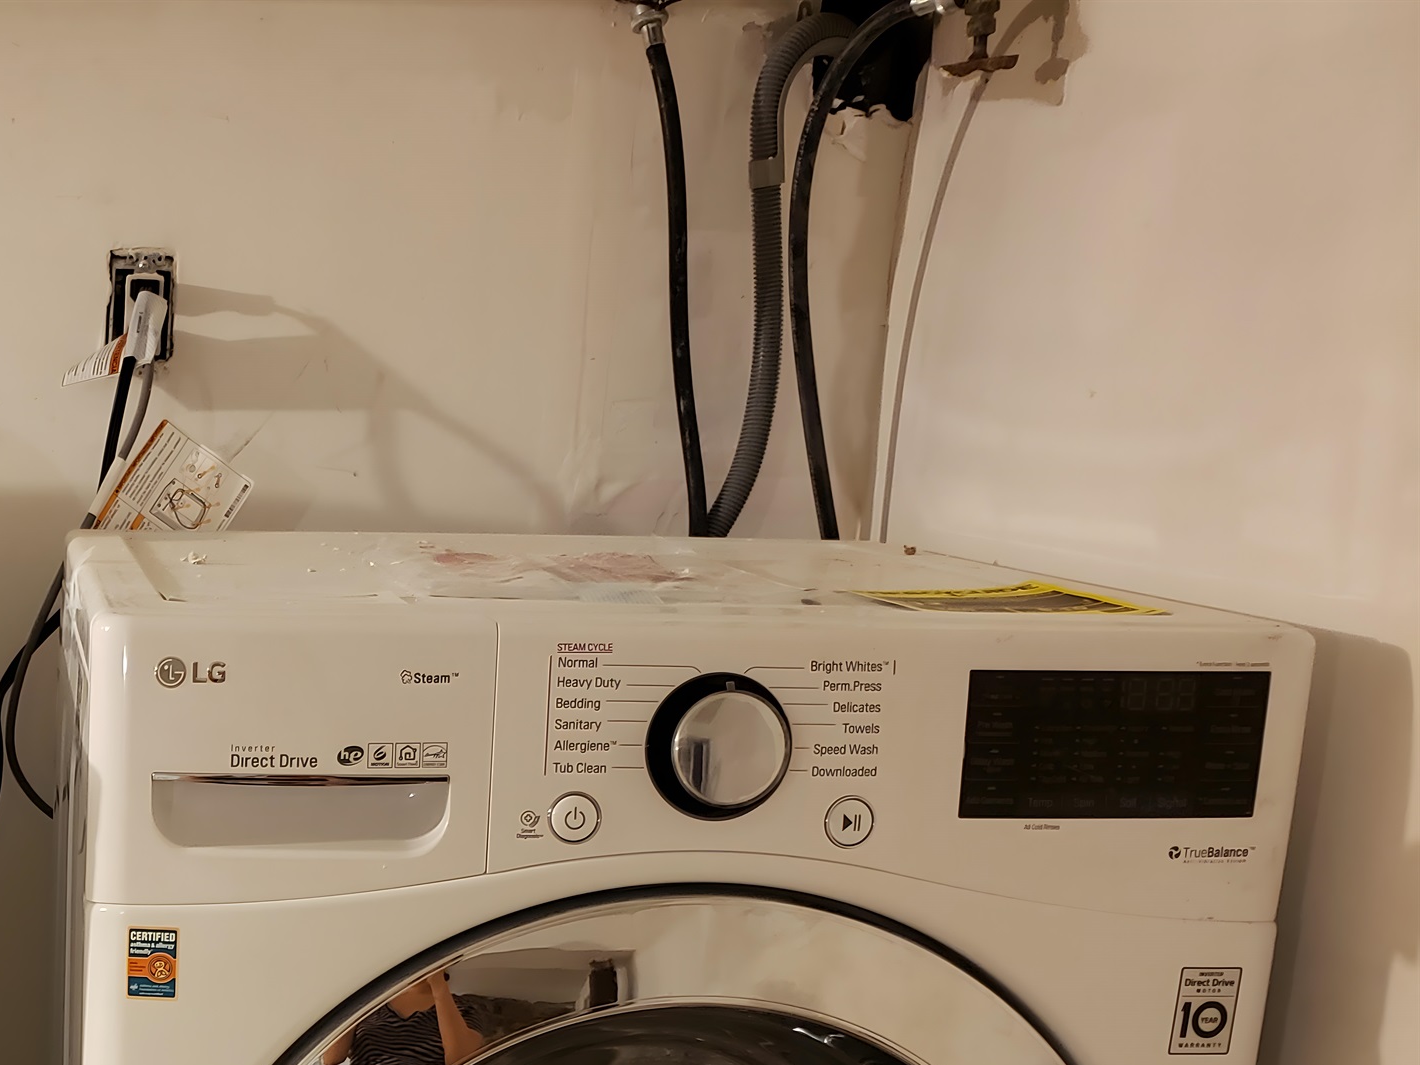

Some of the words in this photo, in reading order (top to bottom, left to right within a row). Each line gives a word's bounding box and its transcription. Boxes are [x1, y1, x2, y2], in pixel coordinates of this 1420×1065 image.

[557, 643, 586, 652] STEAM
[587, 643, 613, 652] CYCLE
[557, 657, 598, 669] Normal
[810, 660, 843, 673] Bright
[192, 661, 228, 684] LG
[556, 677, 593, 691] Heavy
[595, 677, 621, 691] Duty
[555, 698, 601, 712] Bedding
[833, 701, 881, 714] Delicates
[554, 718, 602, 733] Sanitary
[842, 723, 880, 735] Towels
[230, 744, 276, 753] Inverter
[813, 744, 845, 757] Speed
[849, 744, 879, 756] Wash
[230, 755, 276, 768] Direct
[279, 755, 318, 768] Drive
[553, 763, 573, 774] Tub
[576, 763, 607, 774] Clean
[811, 766, 877, 778] Downloaded
[130, 931, 176, 942] CERTIFIED
[1184, 978, 1210, 987] Direct
[1212, 978, 1235, 987] Drive
[1180, 1001, 1228, 1038] 10
